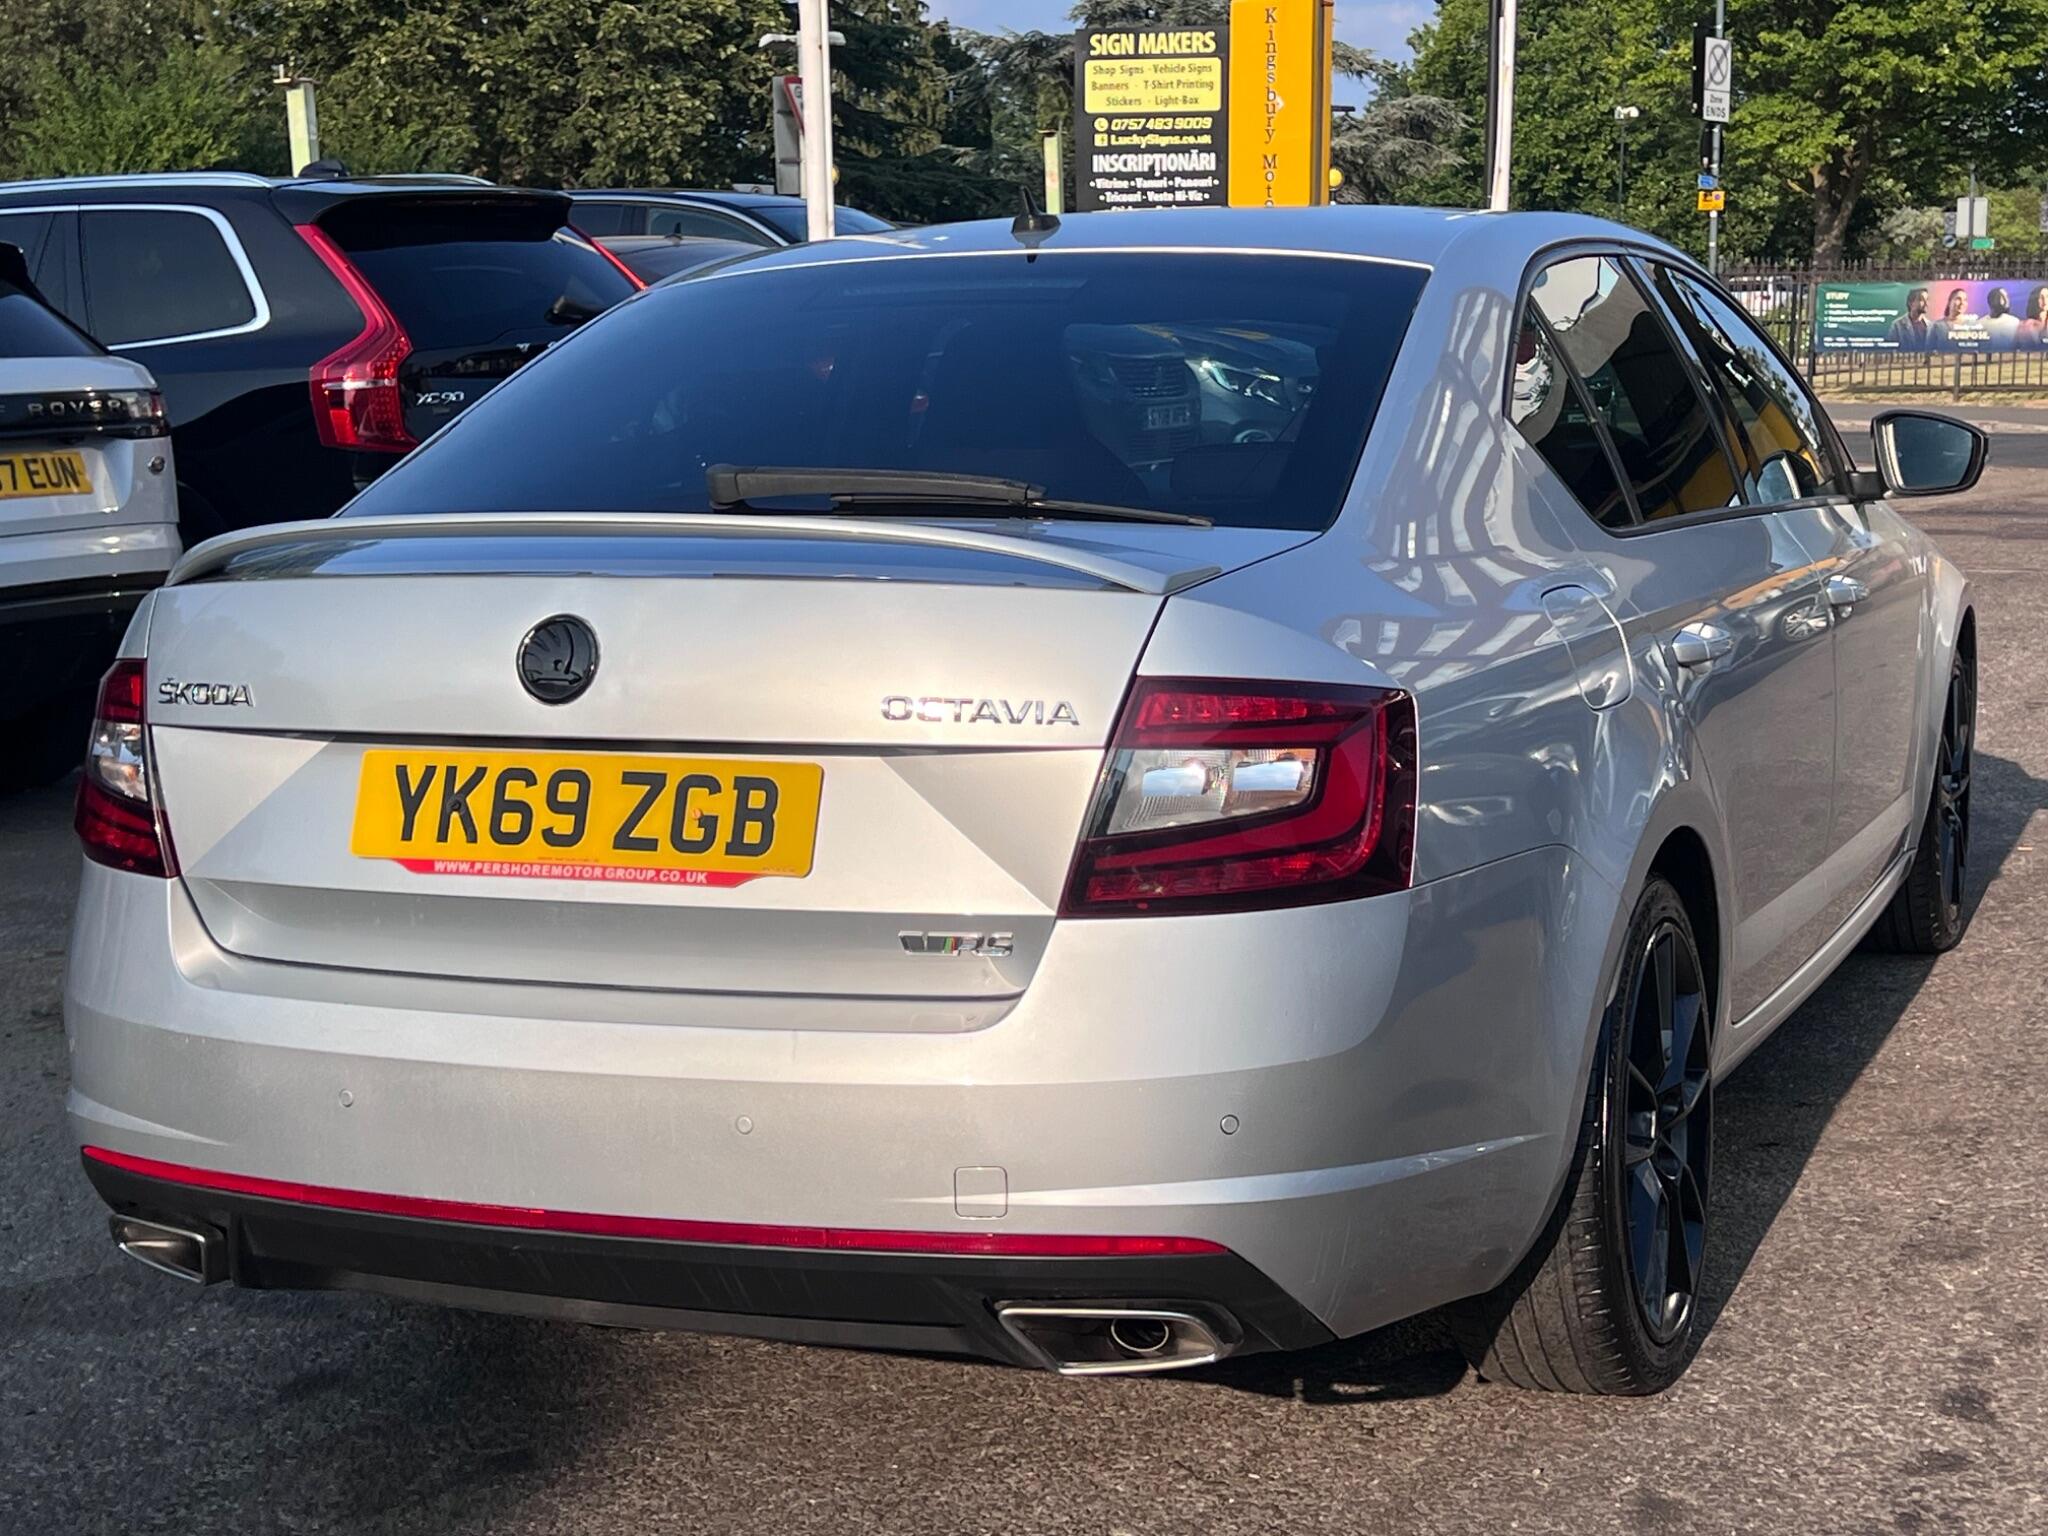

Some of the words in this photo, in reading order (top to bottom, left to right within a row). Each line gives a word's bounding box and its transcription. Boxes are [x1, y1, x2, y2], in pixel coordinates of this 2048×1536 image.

[1089, 33, 1135, 56] SIGN
[1138, 31, 1216, 54] MAKERS
[1093, 65, 1116, 76] Shop
[1120, 65, 1144, 76] Signs
[1152, 64, 1185, 74] Vehicle
[1188, 63, 1212, 75] Signs
[1264, 7, 1278, 144] Kingsbury
[1091, 81, 1129, 91] Banners
[1143, 80, 1174, 90] T-Shirt
[1176, 79, 1214, 91] Printing
[1106, 97, 1142, 106] Stickers
[1706, 105, 1726, 119] ENDS
[416, 391, 465, 406] XC90
[22, 455, 81, 490] EUN
[158, 677, 256, 708] ŠKODA
[880, 695, 1080, 726] OCTAVIA
[395, 764, 591, 848] YK69
[611, 770, 779, 858] ZGB
